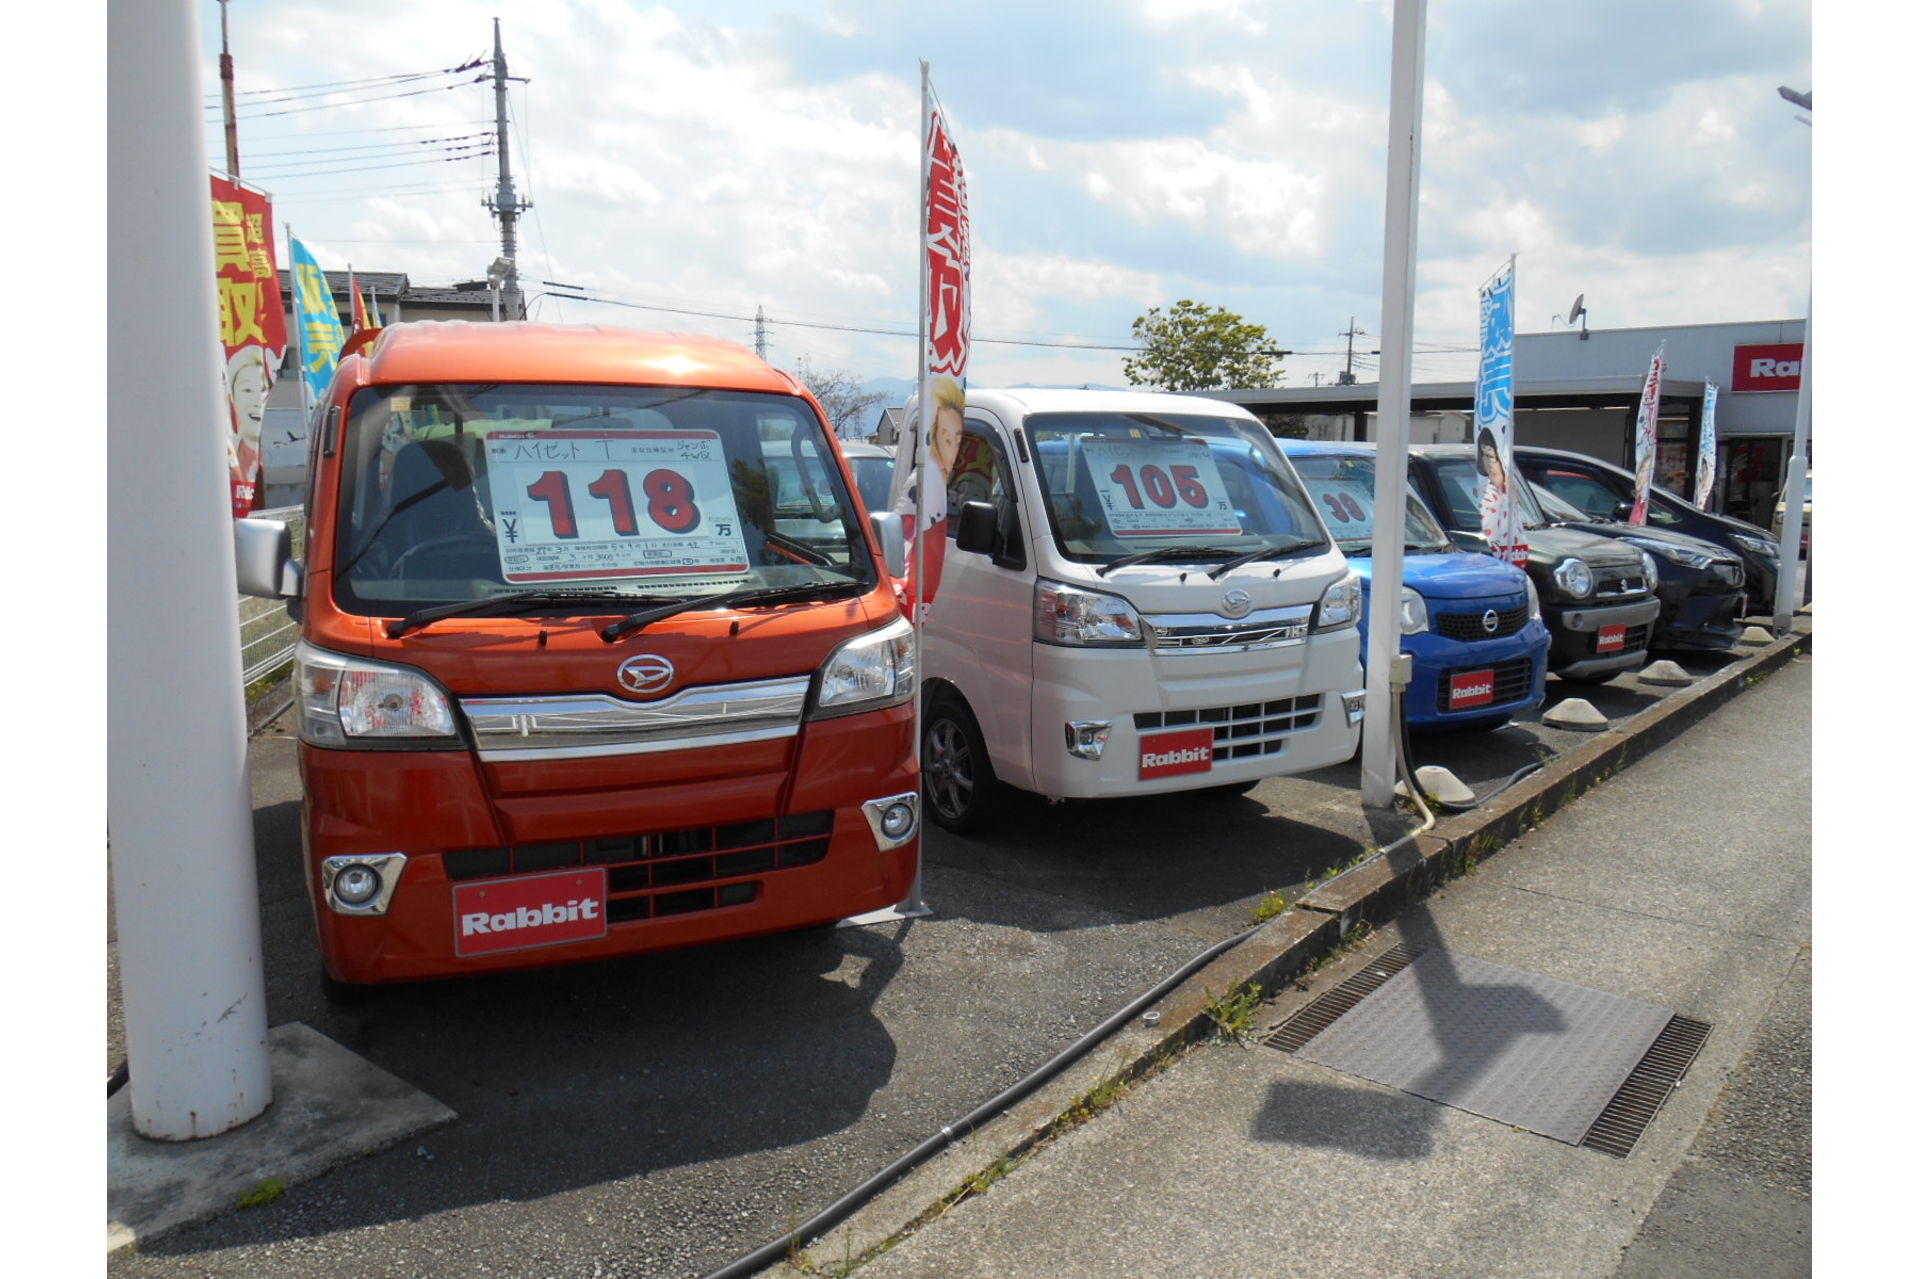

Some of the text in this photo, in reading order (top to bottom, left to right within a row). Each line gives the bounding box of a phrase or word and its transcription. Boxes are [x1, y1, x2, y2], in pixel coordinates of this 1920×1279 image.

[1110, 464, 1209, 510] 105
[527, 468, 701, 539] 118
[502, 519, 518, 543] ¥
[715, 523, 732, 536] 万
[1599, 633, 1624, 645] Rabbit
[1452, 684, 1492, 700] Rabbit
[1142, 746, 1209, 768] Rabbit
[462, 898, 599, 936] Rabbit
